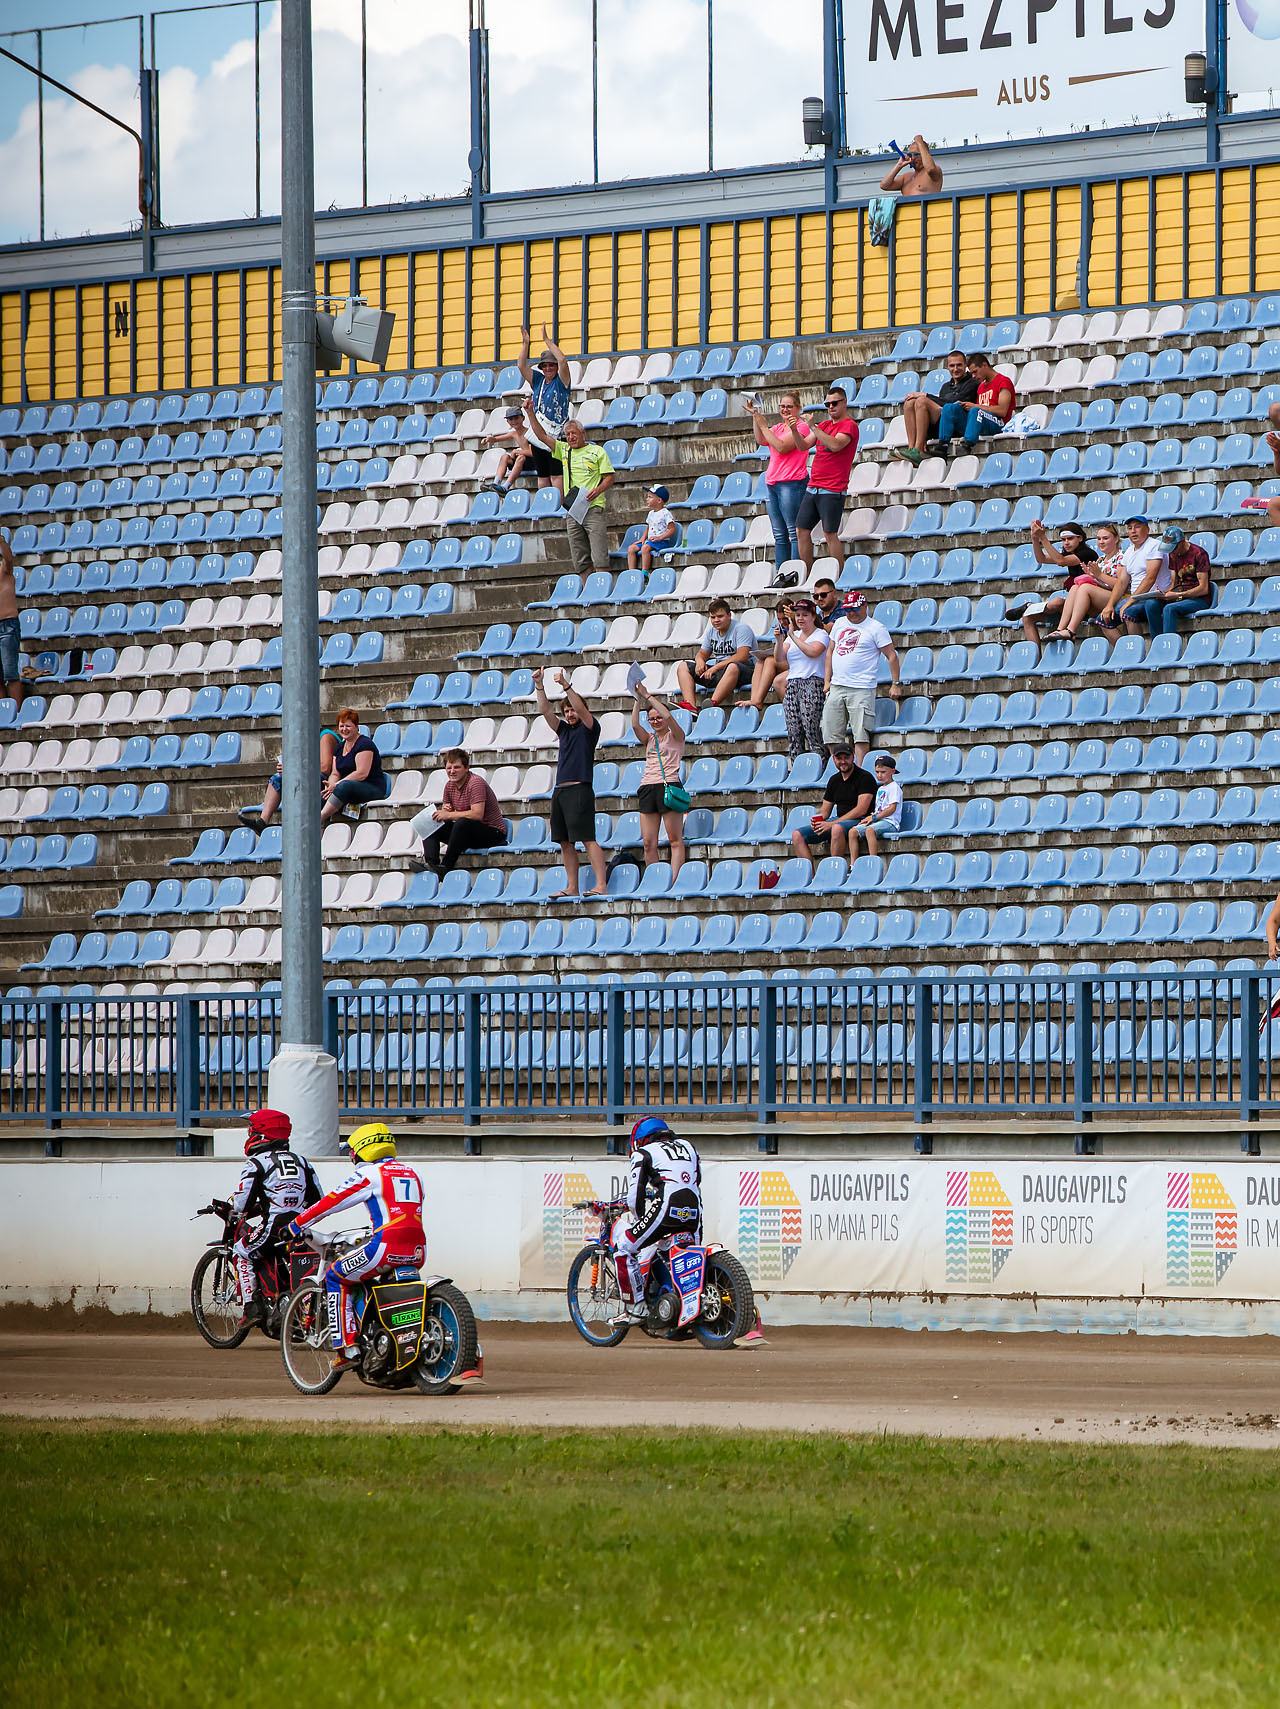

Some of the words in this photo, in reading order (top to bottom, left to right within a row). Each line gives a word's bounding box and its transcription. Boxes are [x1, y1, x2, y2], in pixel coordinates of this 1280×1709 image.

[997, 75, 1050, 106] ALUS
[1196, 848, 1206, 856] 22
[662, 1144, 691, 1161] 14
[280, 1160, 299, 1177] 15
[399, 1179, 411, 1201] 7
[810, 1173, 909, 1202] DAUGAVPILS
[1023, 1175, 1128, 1204] DAUGAVPILS
[810, 1213, 822, 1241] IR
[828, 1213, 866, 1241] MANA
[871, 1214, 899, 1242] PILS
[1022, 1215, 1034, 1244] IR
[1040, 1215, 1094, 1245] SPORTS
[1246, 1219, 1260, 1247] IR
